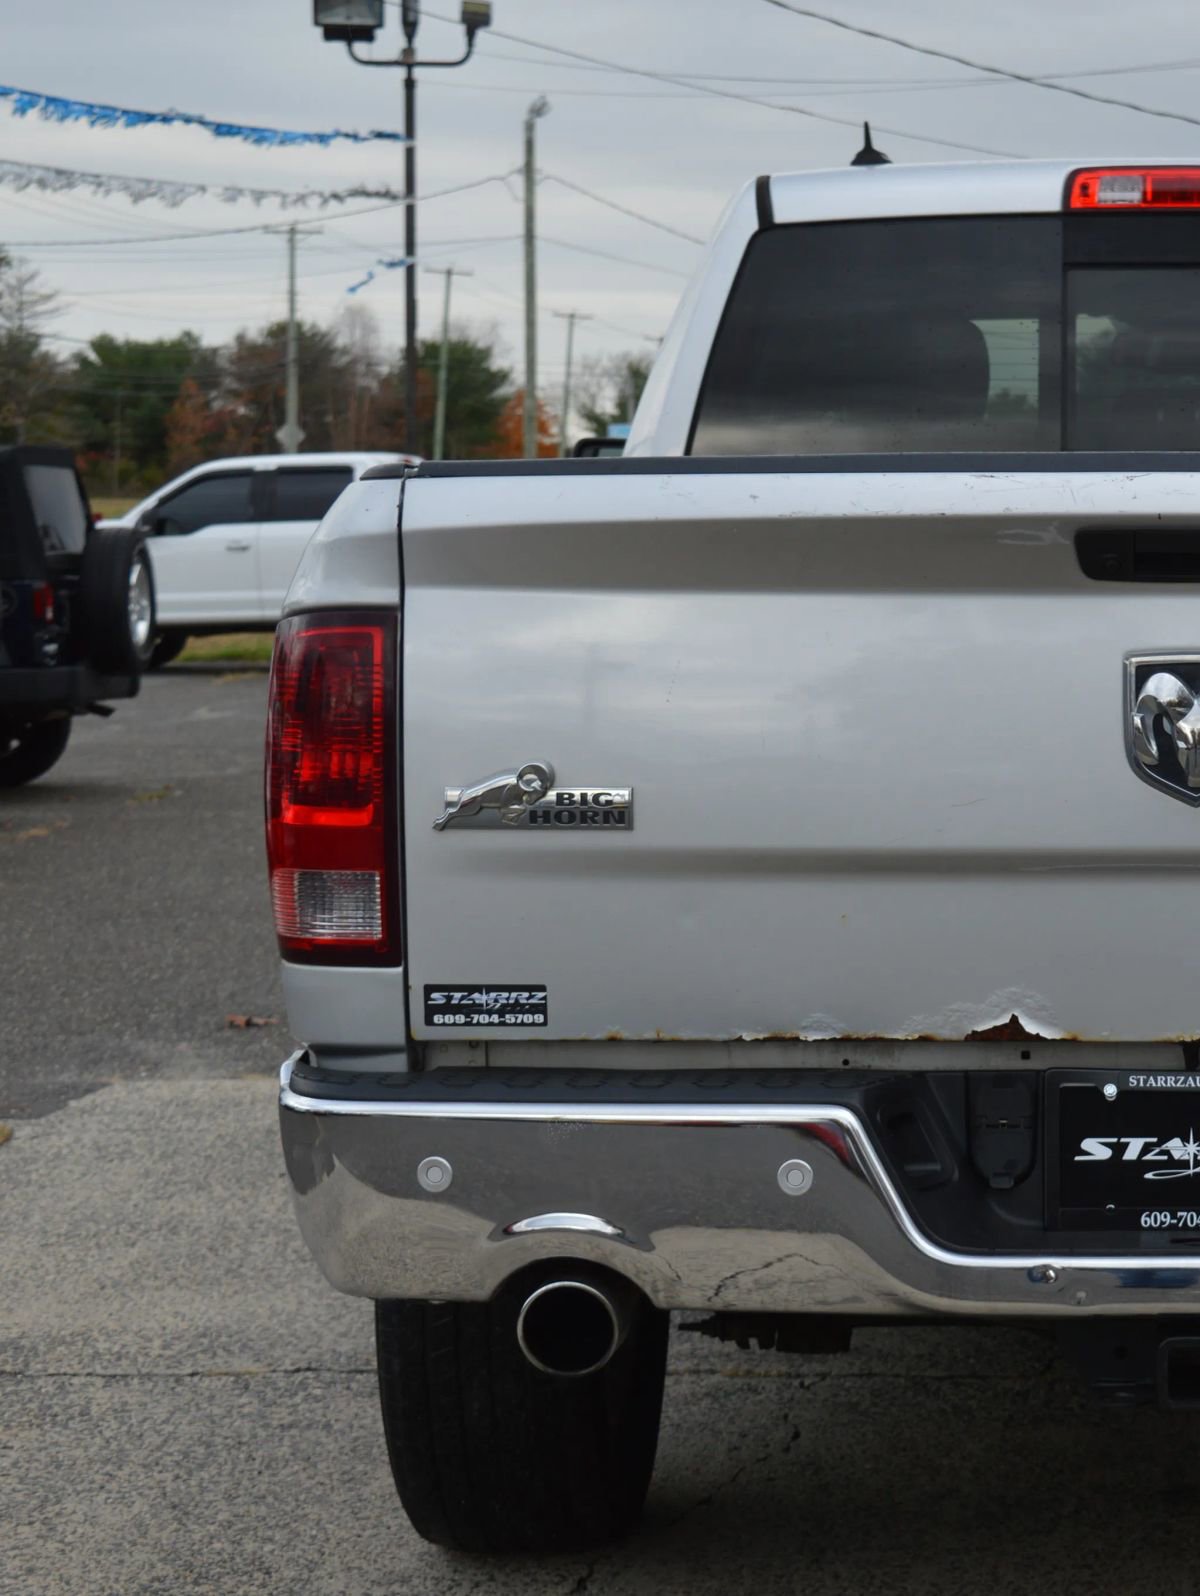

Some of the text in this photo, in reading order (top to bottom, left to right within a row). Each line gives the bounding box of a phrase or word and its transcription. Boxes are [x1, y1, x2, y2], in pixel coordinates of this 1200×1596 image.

[555, 792, 616, 807] BIG
[529, 810, 626, 825] HORN
[427, 992, 547, 1004] STARRZ
[433, 1014, 545, 1024] 609-704-5709
